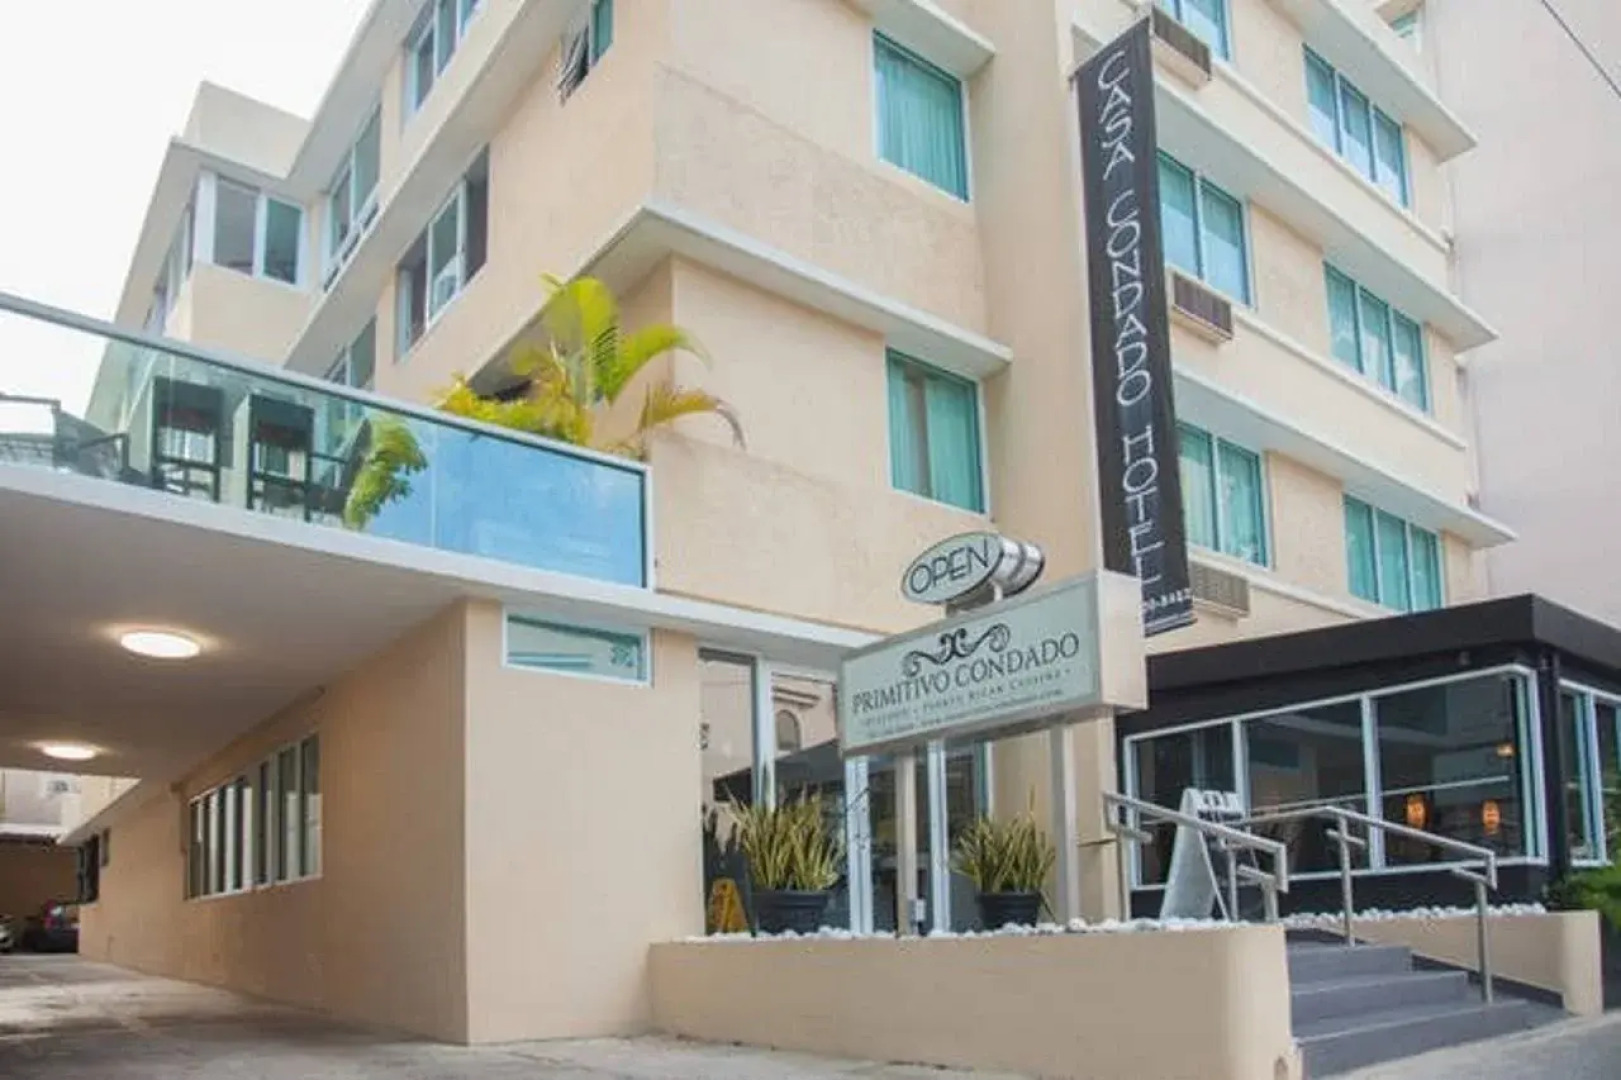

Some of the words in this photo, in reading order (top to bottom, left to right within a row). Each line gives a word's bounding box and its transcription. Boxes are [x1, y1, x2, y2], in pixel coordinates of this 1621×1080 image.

[1097, 50, 1135, 181] CASA
[1106, 189, 1152, 406] CONDADO
[908, 539, 990, 594] OPEN
[1122, 425, 1165, 583] HOTEL
[852, 669, 950, 715] PRIMITIVO
[955, 632, 1080, 687] CONDADO
